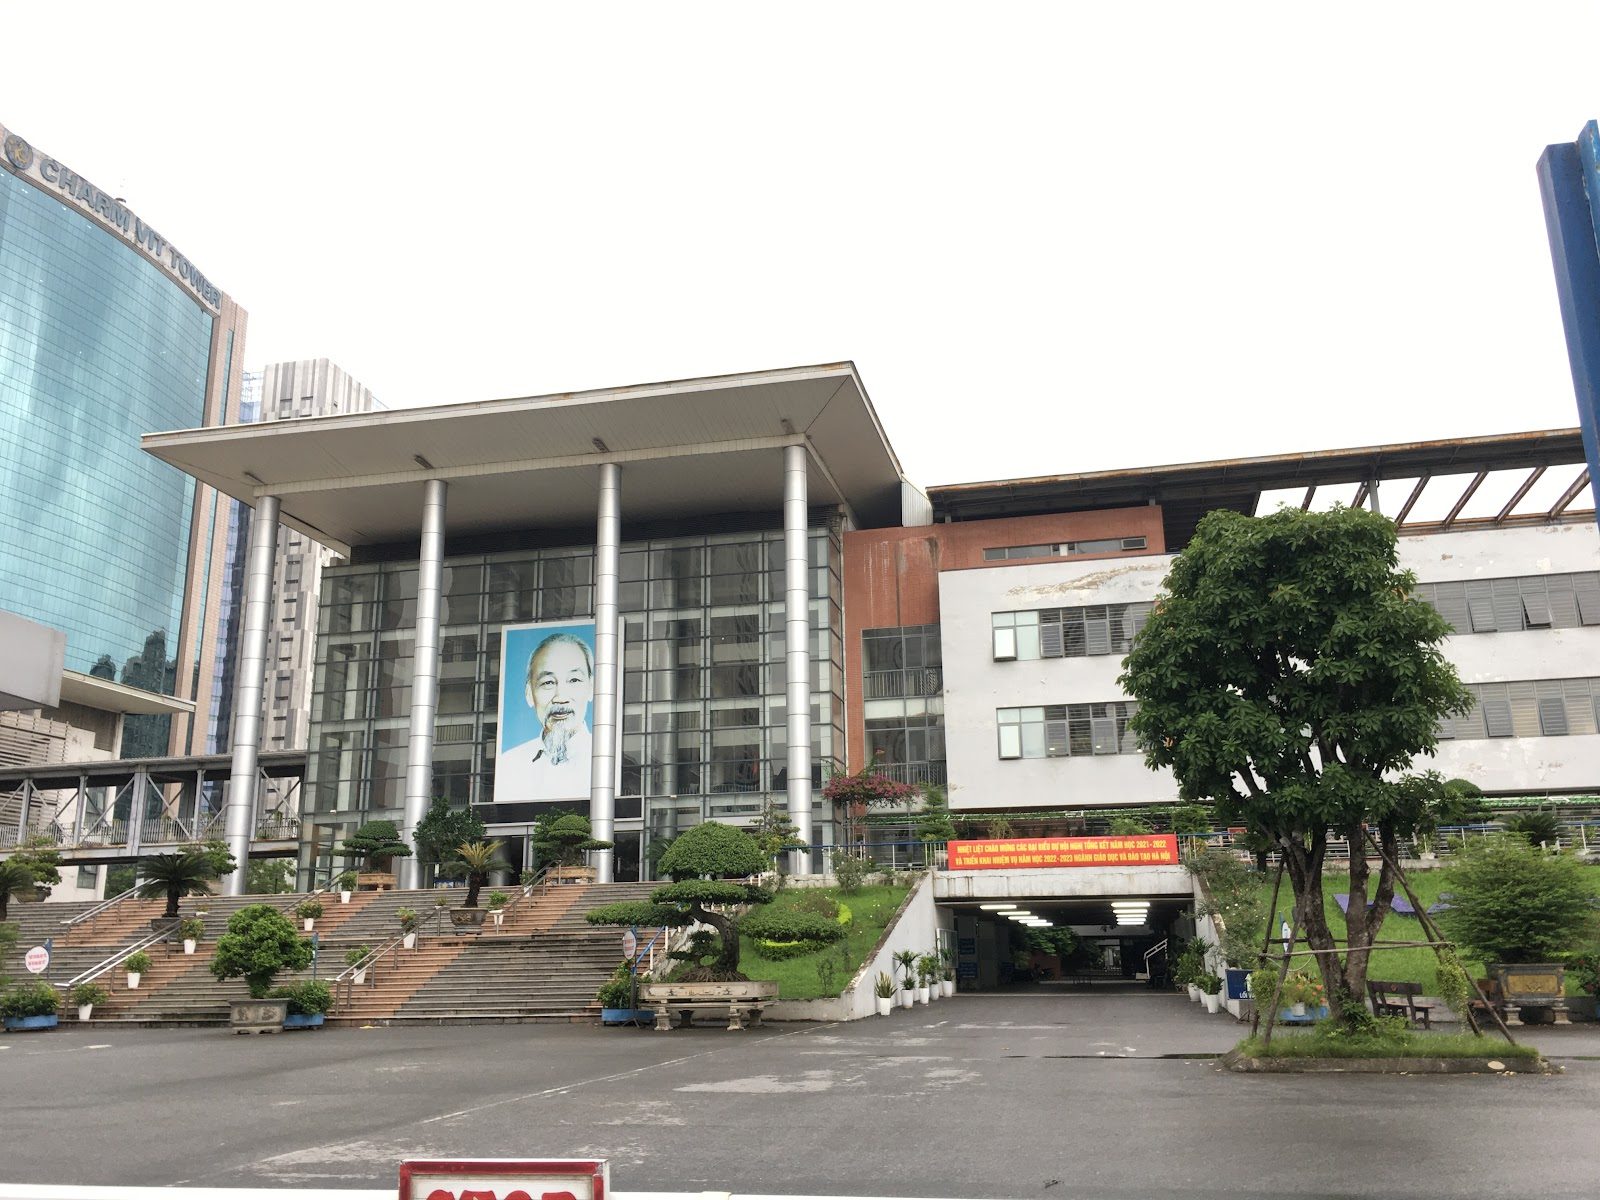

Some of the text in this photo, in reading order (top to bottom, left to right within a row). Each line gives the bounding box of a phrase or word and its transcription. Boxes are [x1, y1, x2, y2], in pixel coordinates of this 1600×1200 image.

[40, 158, 222, 309] CHARM VIT TOWER
[973, 844, 983, 853] LIỆT
[985, 844, 998, 853] CHÀO
[1016, 842, 1027, 851] CÁC
[1084, 840, 1098, 850] TỔNG
[1099, 840, 1109, 849] KẾT
[1110, 840, 1123, 849] NĂM
[1124, 840, 1135, 850] HỌC
[955, 856, 963, 865] VÀ
[1010, 856, 1017, 865] VỤ
[1018, 854, 1031, 863] NĂM
[1031, 855, 1042, 864] HỌC
[1073, 853, 1093, 862] NGÀNH
[1094, 852, 1106, 861] GIÁO
[1107, 853, 1118, 862] DỤC
[1119, 852, 1127, 861] VÀ
[1128, 851, 1139, 860] ĐÀO
[1140, 852, 1150, 862] TẠO
[1151, 851, 1159, 860] HÀ
[1160, 851, 1170, 861] NỘI
